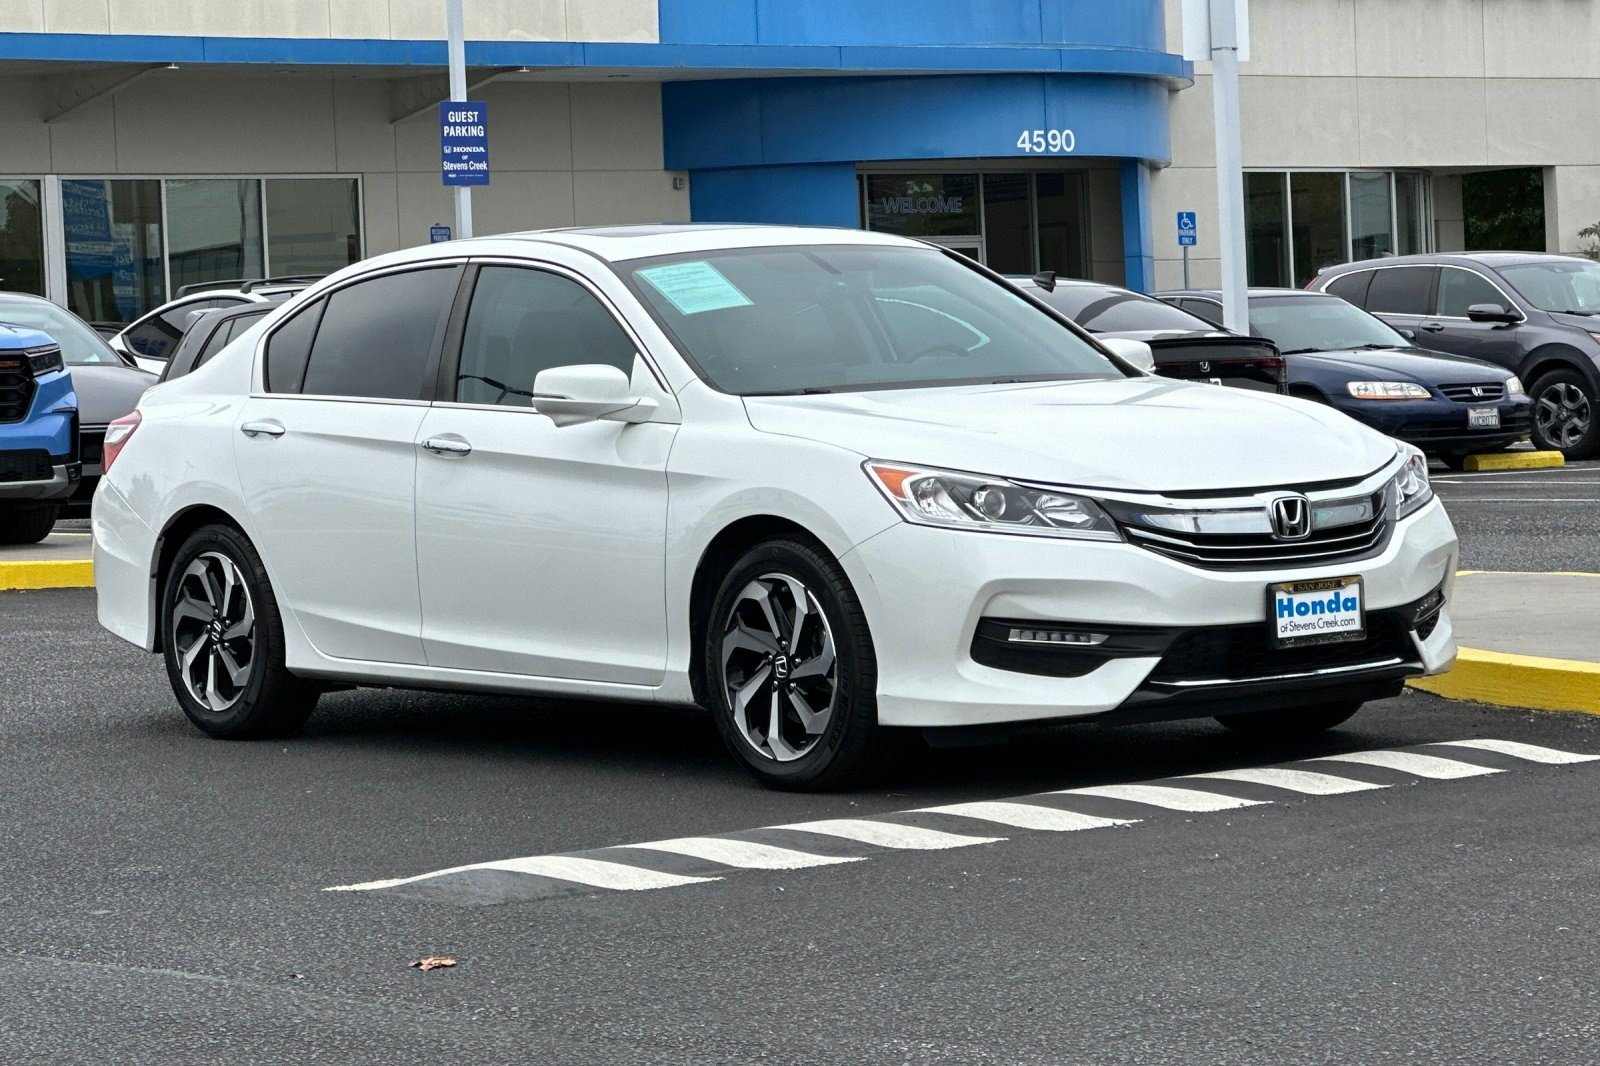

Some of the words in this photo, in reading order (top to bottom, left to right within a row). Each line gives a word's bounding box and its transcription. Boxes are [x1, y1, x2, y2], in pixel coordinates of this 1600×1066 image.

[448, 111, 478, 122] GUEST
[443, 125, 484, 136] PARKING
[1016, 129, 1075, 152] 4590
[443, 161, 468, 171] Stevens
[469, 160, 488, 171] Creek
[882, 195, 963, 214] WELCOME
[1297, 583, 1315, 591] SAN
[1277, 592, 1357, 618] Honda
[1280, 624, 1288, 633] of
